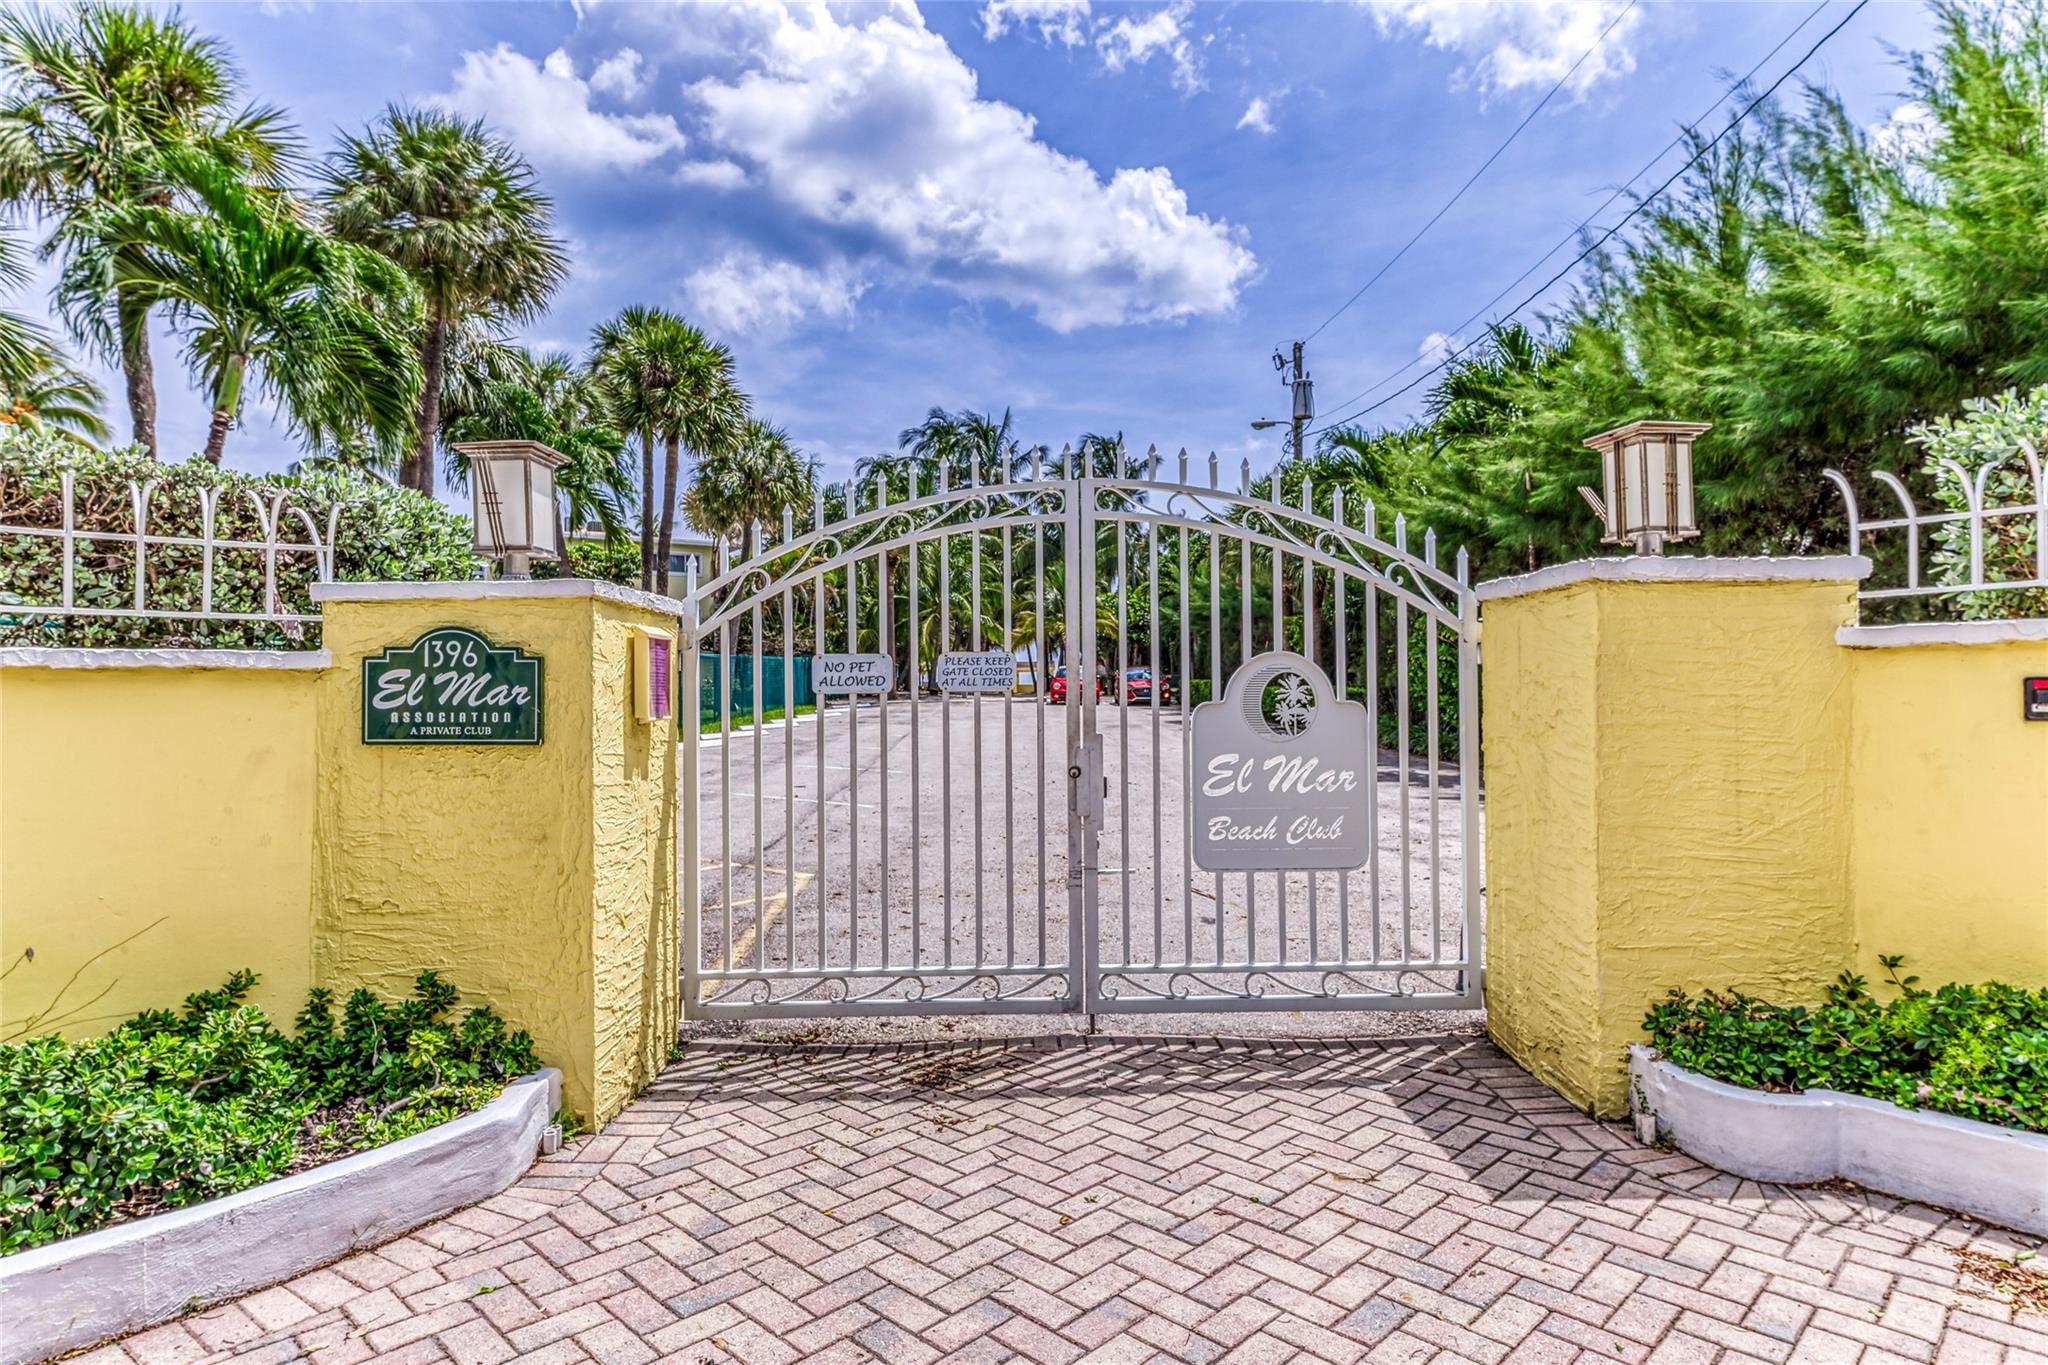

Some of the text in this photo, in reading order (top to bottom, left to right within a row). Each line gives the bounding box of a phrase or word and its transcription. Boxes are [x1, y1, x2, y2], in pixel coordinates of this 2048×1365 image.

[424, 640, 478, 667] 1396
[824, 661, 875, 673] NO PET
[944, 656, 1011, 666] PLEASE KEEP
[942, 667, 1013, 676] GATE CLOSED
[819, 675, 886, 687] ALLOWED
[942, 677, 1013, 687] AT ALL TIMES
[372, 668, 531, 709] El Mar
[390, 711, 511, 723] ASSOCIATION
[410, 726, 492, 735] A PRIVATE CLUB
[1202, 753, 1358, 797] El Mar
[1207, 815, 1345, 845] Beach Club
